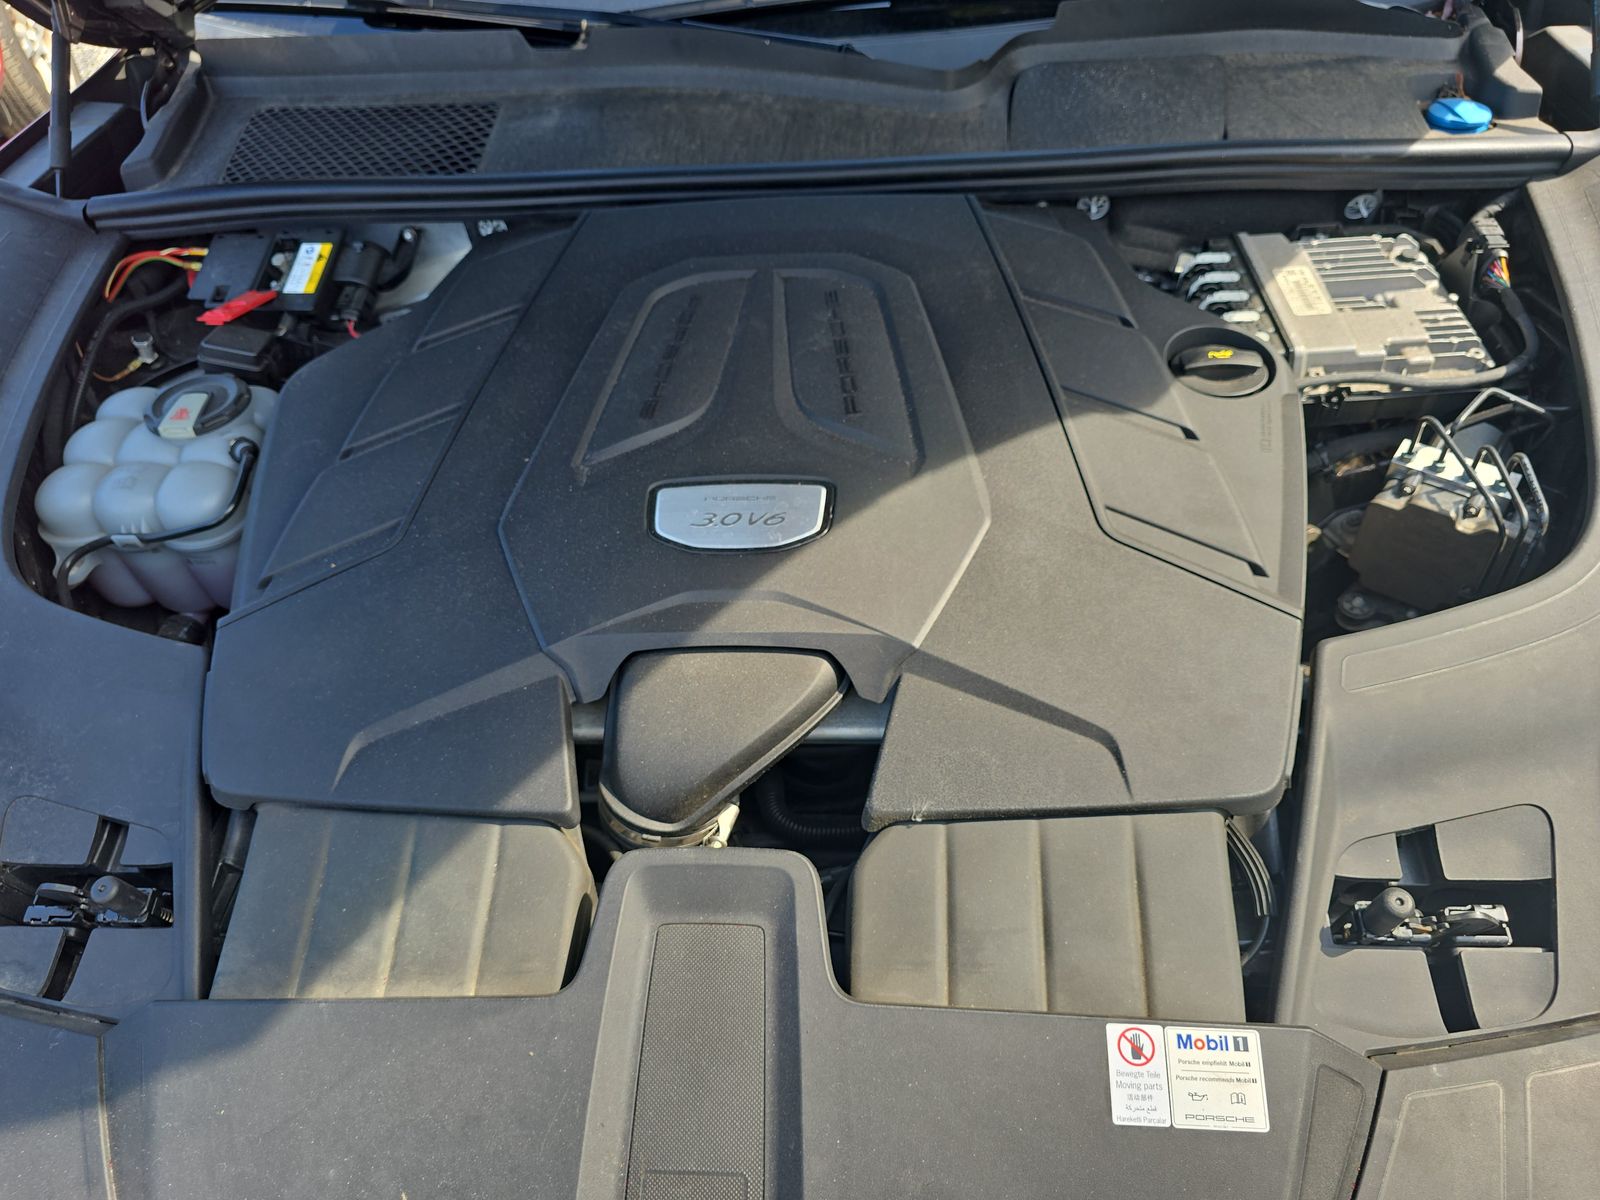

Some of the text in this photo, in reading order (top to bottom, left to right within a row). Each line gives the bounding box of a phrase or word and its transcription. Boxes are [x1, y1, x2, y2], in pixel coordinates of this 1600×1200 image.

[1176, 1033, 1230, 1052] Mobil
[1178, 1058, 1201, 1066] Porsche
[1116, 1069, 1161, 1079] Bewegte Teile
[1176, 1074, 1198, 1082] Porsche
[1199, 1076, 1235, 1084] recommends
[1115, 1080, 1163, 1091] Moving parts
[1185, 1113, 1256, 1123] PORSCHE
